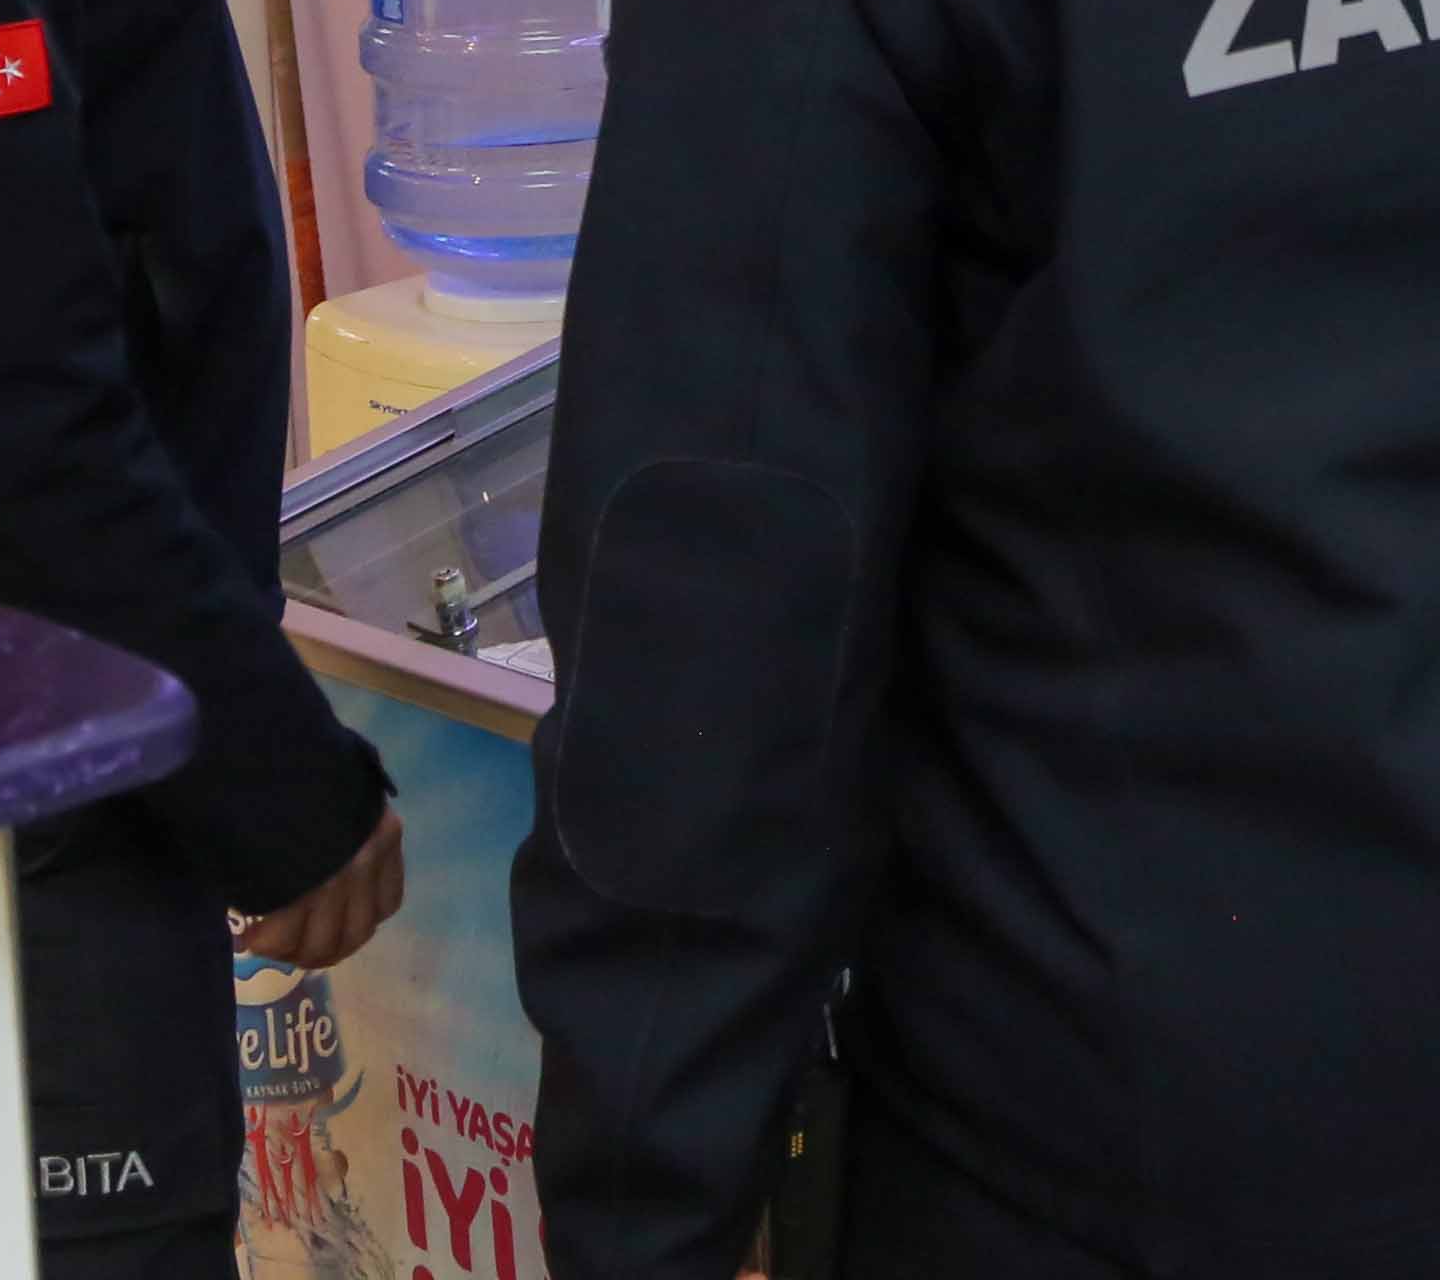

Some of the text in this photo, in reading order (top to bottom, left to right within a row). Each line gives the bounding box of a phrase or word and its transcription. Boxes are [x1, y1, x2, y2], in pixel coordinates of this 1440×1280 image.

[396, 1063, 441, 1127] İYİ
[39, 1150, 155, 1197] BITA
[401, 1127, 518, 1280] İYİ
